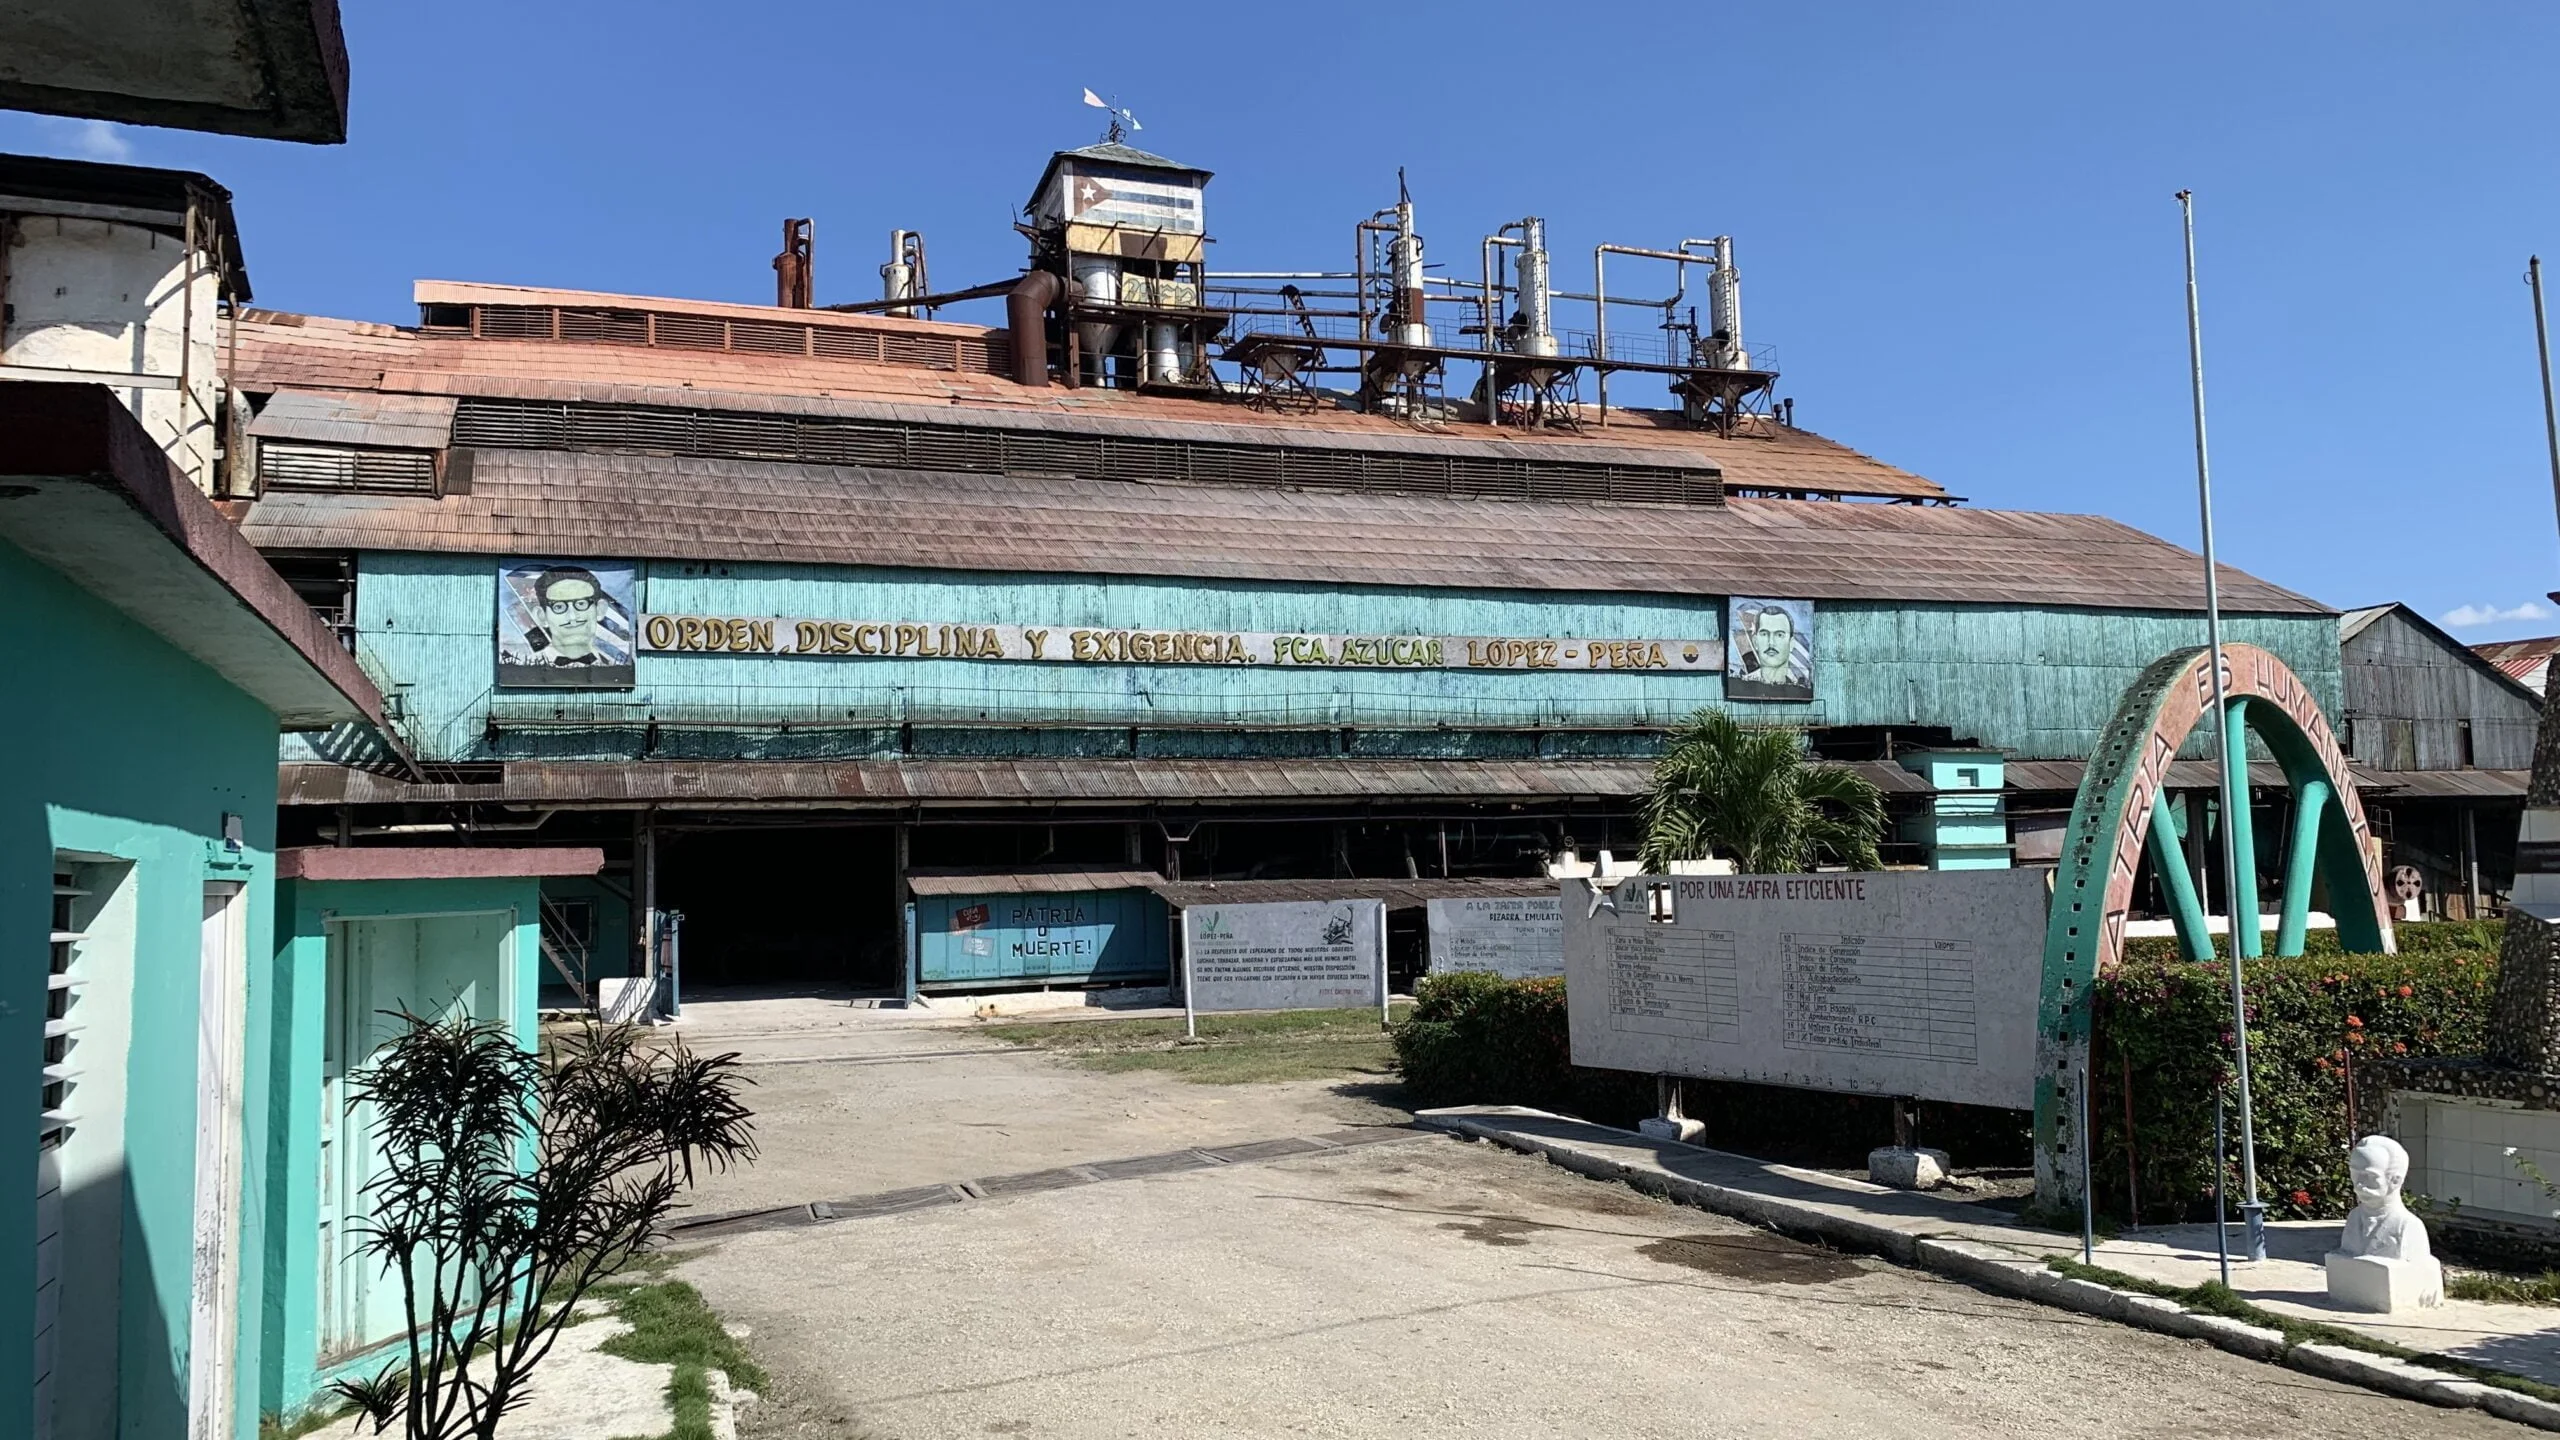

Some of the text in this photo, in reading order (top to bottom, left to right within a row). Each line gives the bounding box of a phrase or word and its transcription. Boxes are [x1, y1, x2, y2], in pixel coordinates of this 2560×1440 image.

[796, 622, 1005, 658] DISCIPLINA
[1025, 629, 1048, 659] Y
[1070, 630, 1256, 663] EXIGENCIA.
[1588, 641, 1669, 668] PEÑA
[2098, 731, 2173, 967] ATRIA
[2253, 653, 2381, 896] HUMANIDAD
[1680, 879, 1865, 900] POR UNA ZAFRA EFICIENTE
[1012, 907, 1085, 924] PATRIA
[1037, 925, 1047, 937] O
[1012, 940, 1091, 957] MUERTE!
[1850, 1080, 1859, 1089] 10
